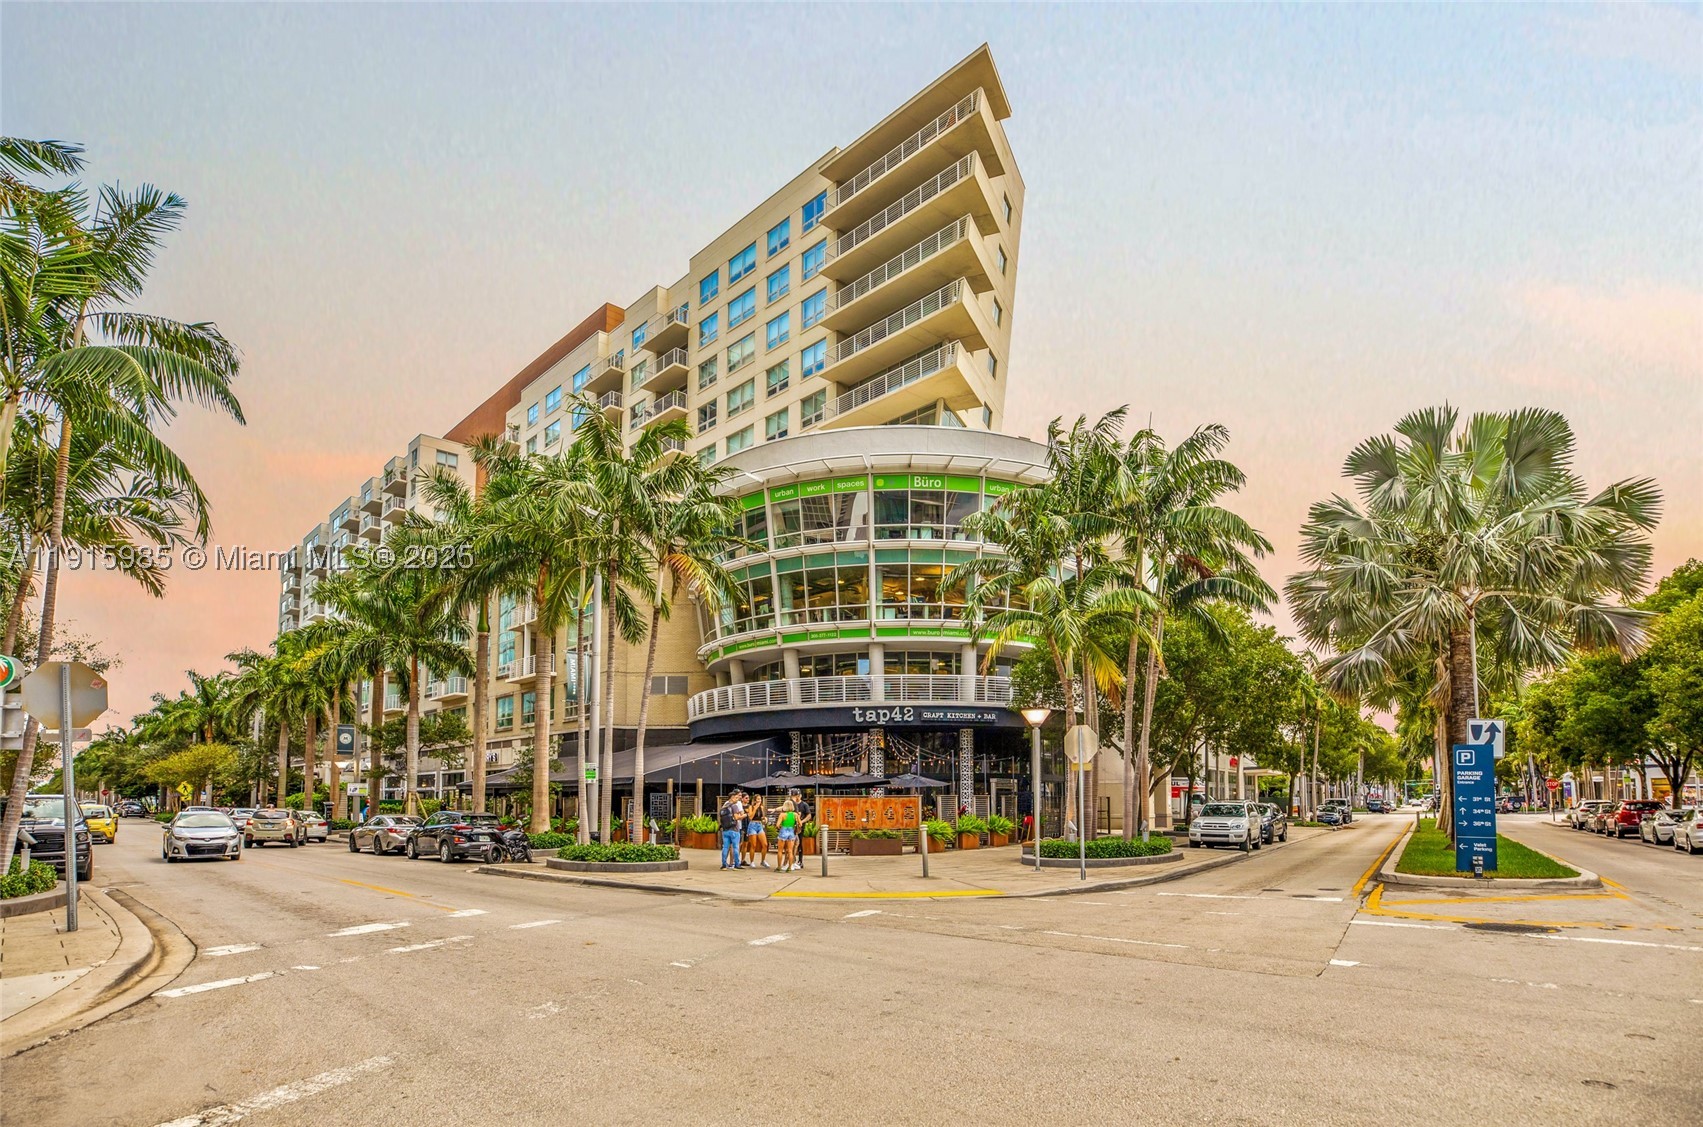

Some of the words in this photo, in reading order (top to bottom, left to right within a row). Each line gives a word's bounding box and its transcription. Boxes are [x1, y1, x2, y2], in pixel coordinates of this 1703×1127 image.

[775, 488, 794, 498] urban
[806, 483, 825, 492] work
[837, 480, 865, 489] spaces
[913, 475, 942, 488] Büro
[852, 706, 914, 725] tap42
[1460, 752, 1471, 763] P
